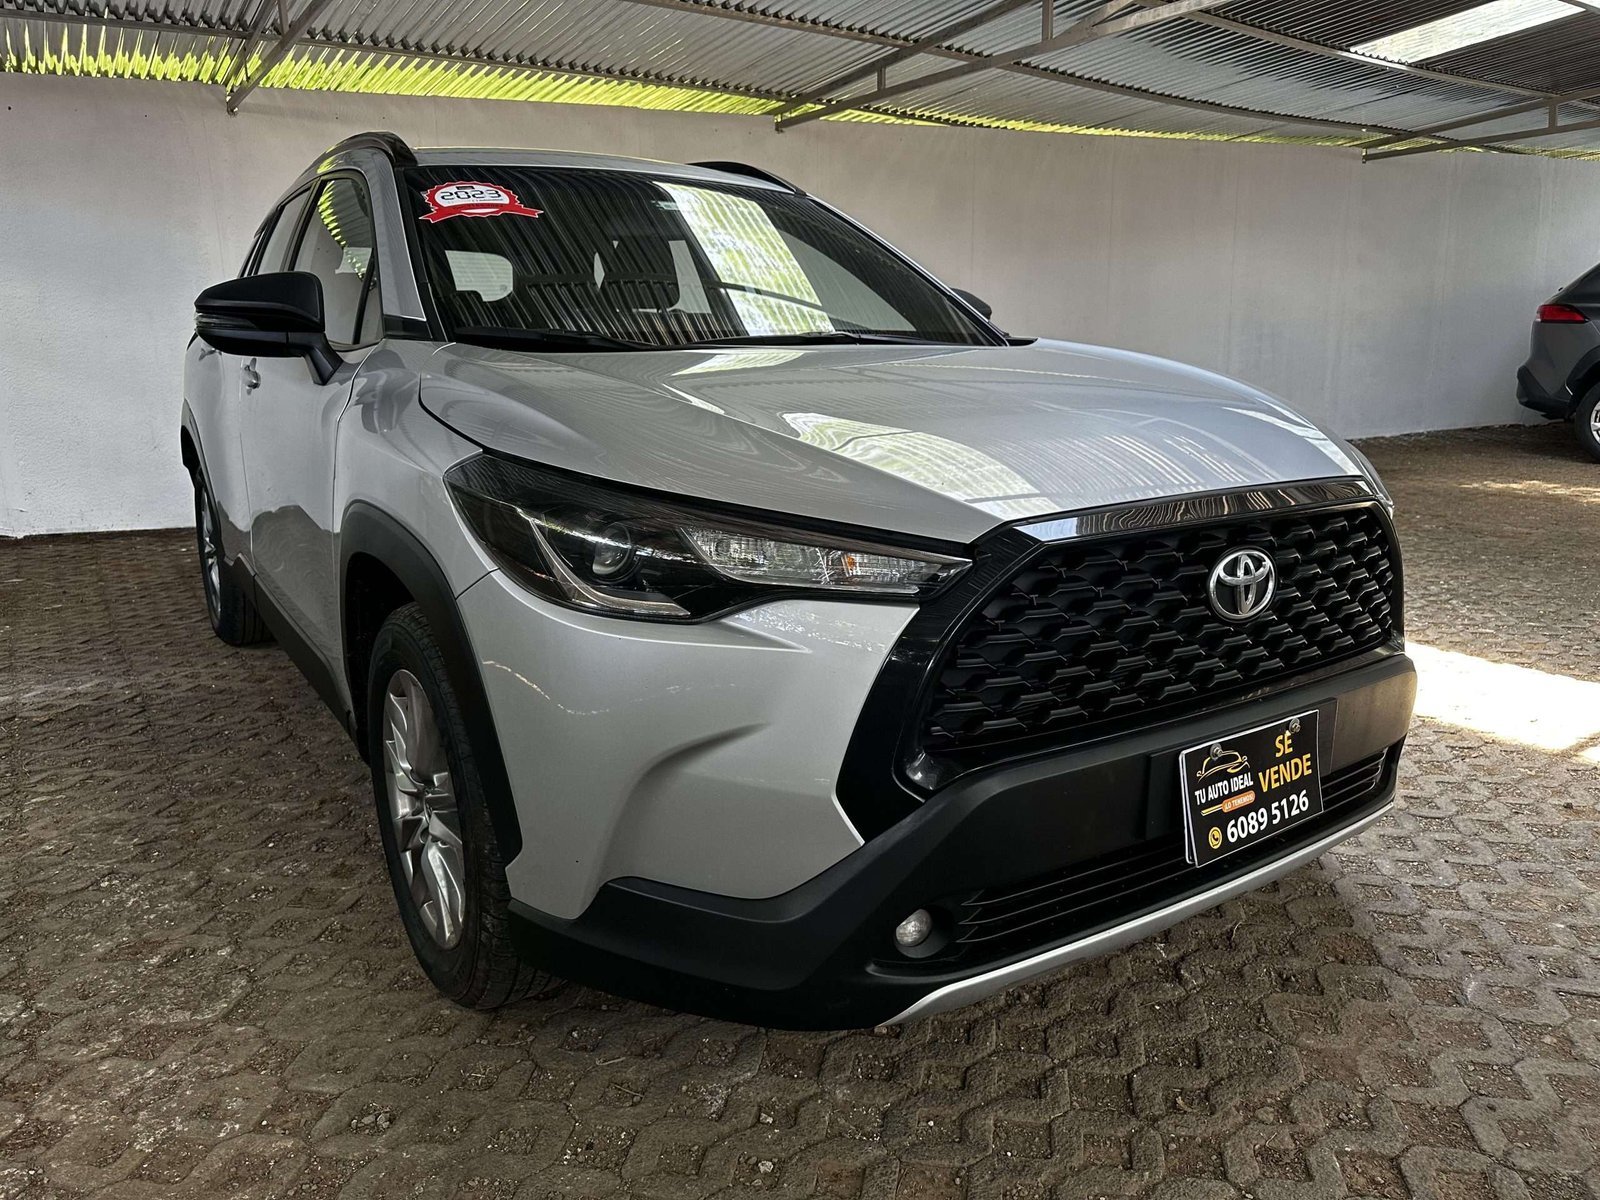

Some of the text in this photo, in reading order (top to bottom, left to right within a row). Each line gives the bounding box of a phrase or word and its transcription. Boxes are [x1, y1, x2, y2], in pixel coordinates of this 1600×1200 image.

[440, 189, 502, 201] 2023
[1194, 772, 1254, 806] TU AUTO IDEAL
[1258, 753, 1313, 793] VENDE
[1226, 789, 1309, 843] 6089 5126
